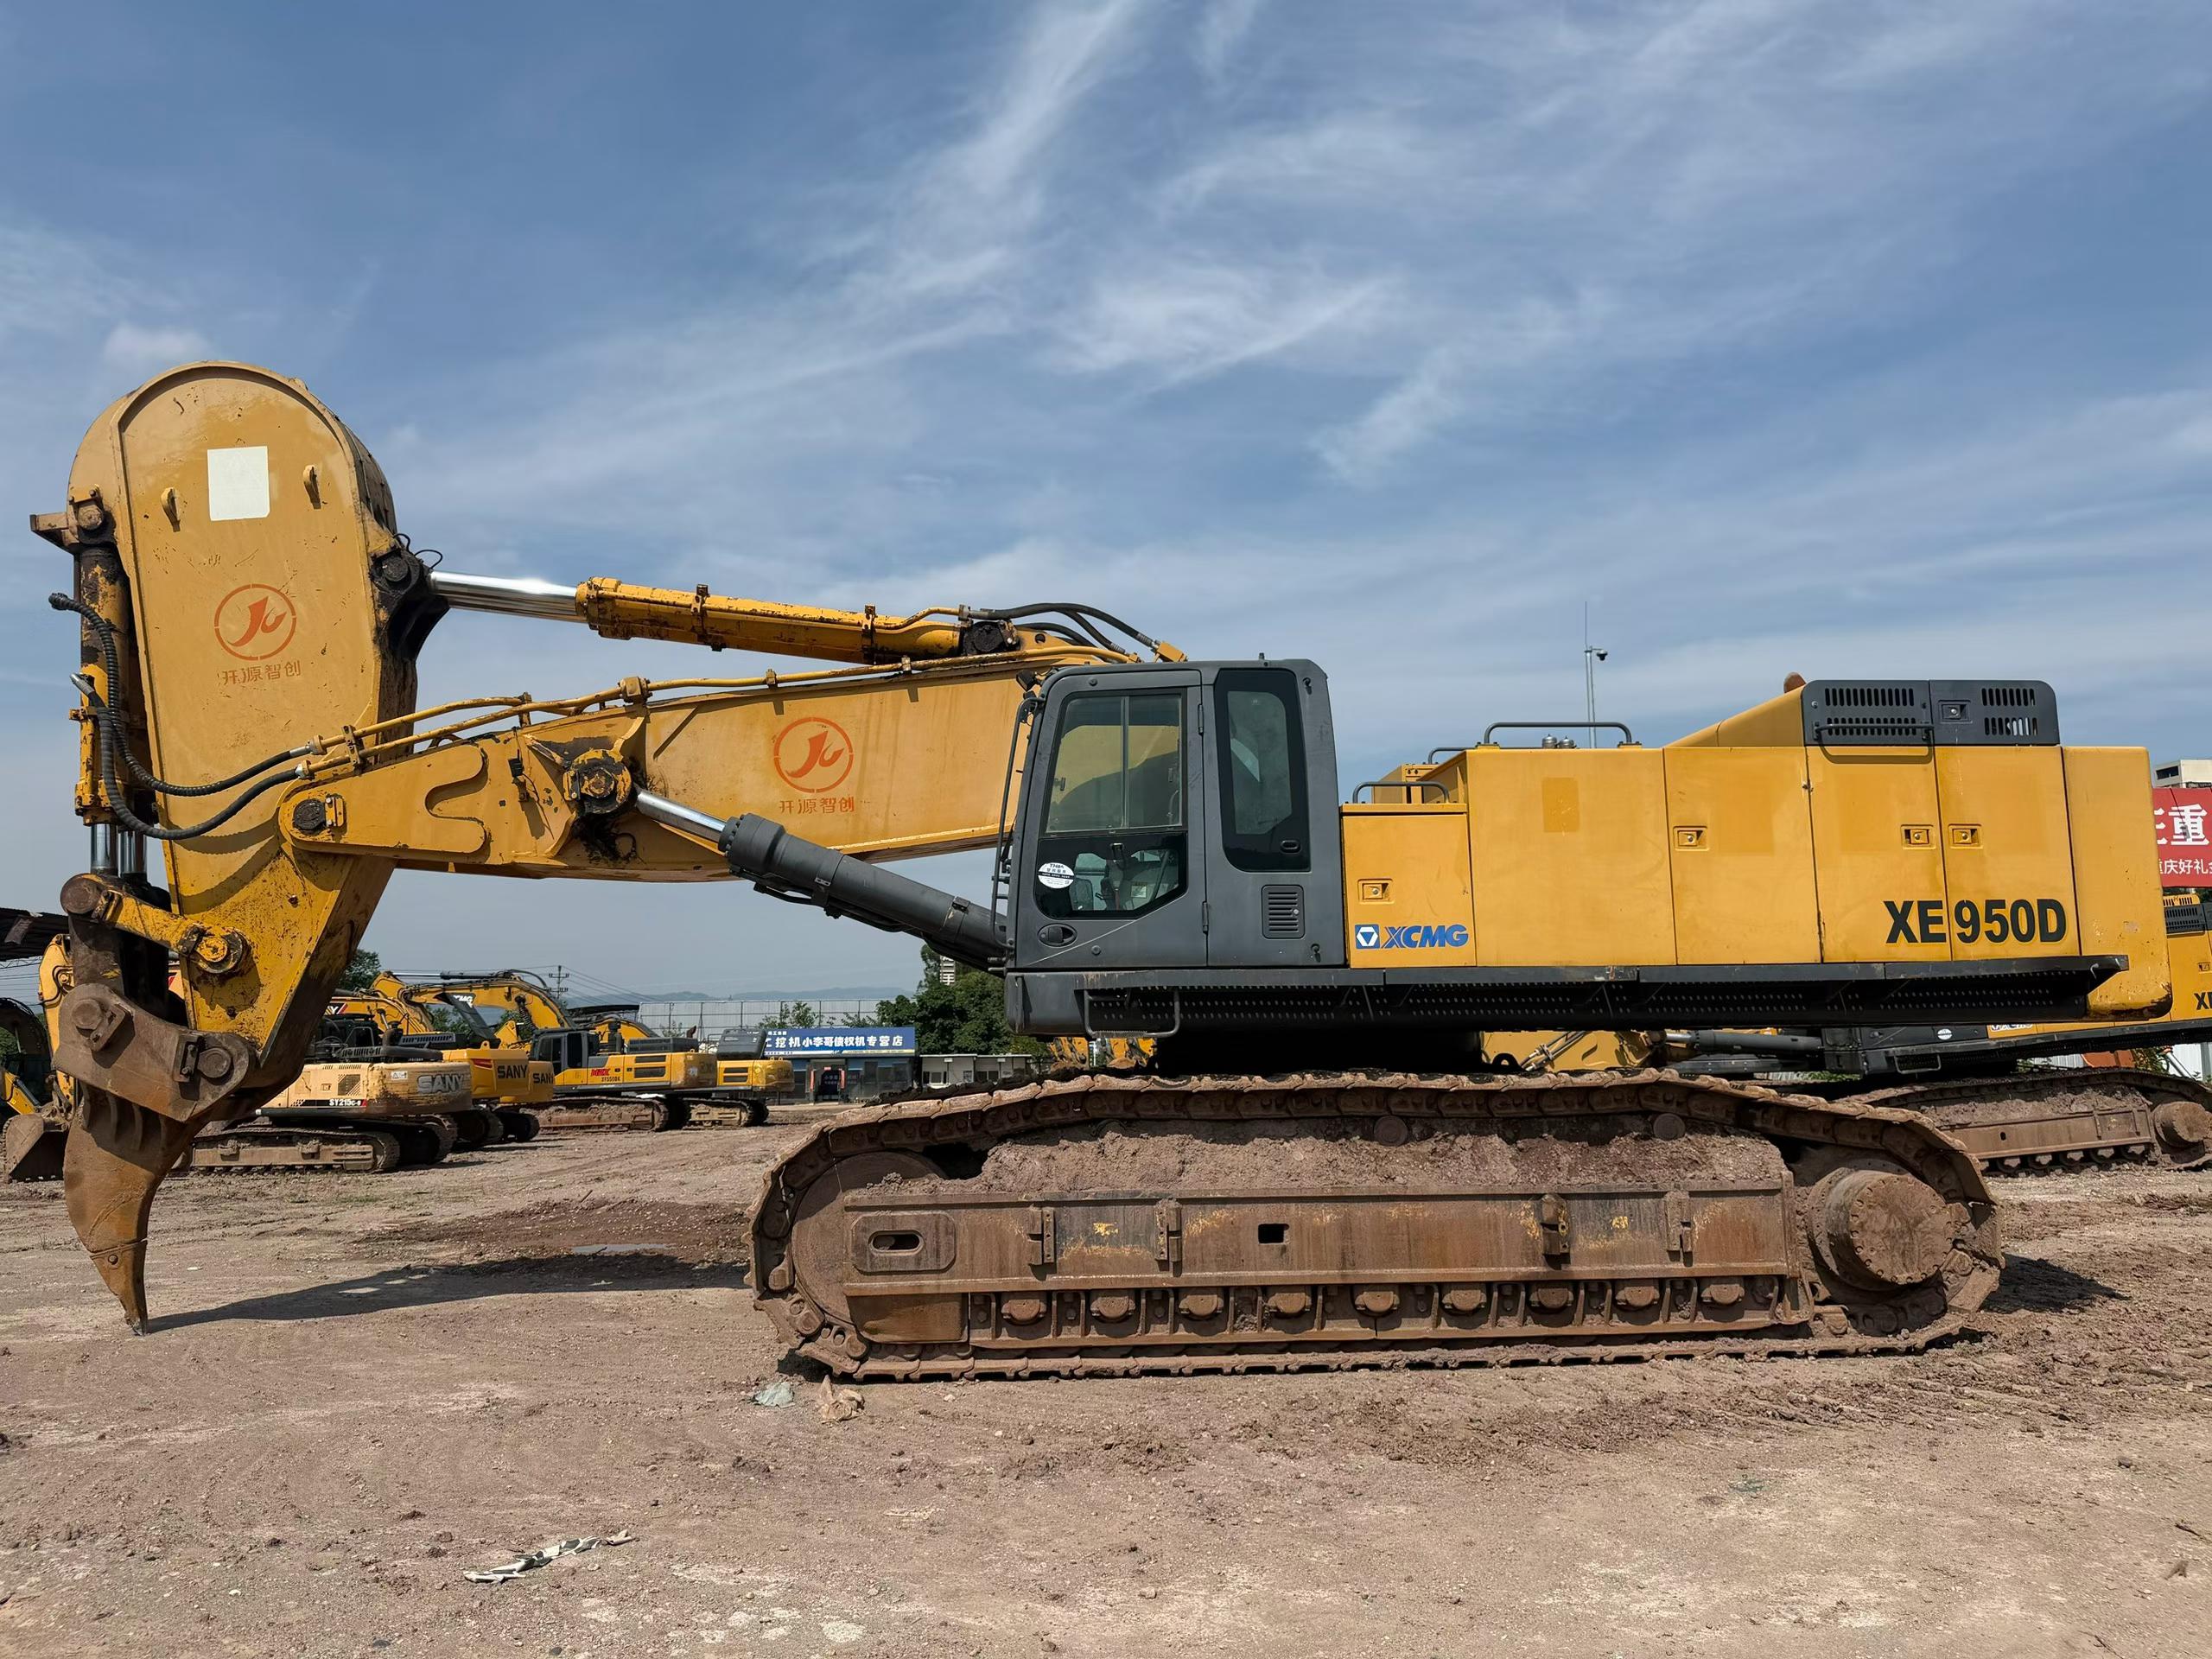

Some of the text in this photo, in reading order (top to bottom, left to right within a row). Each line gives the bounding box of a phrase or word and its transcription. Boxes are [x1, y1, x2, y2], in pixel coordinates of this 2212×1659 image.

[221, 659, 302, 685] 开源智创
[779, 796, 855, 815] 开源智创
[1883, 899, 2067, 944] XE950D
[1381, 924, 1469, 949] XCMG
[497, 1065, 529, 1079] SANY
[533, 1072, 554, 1084] SANY
[416, 1074, 465, 1094] SANY
